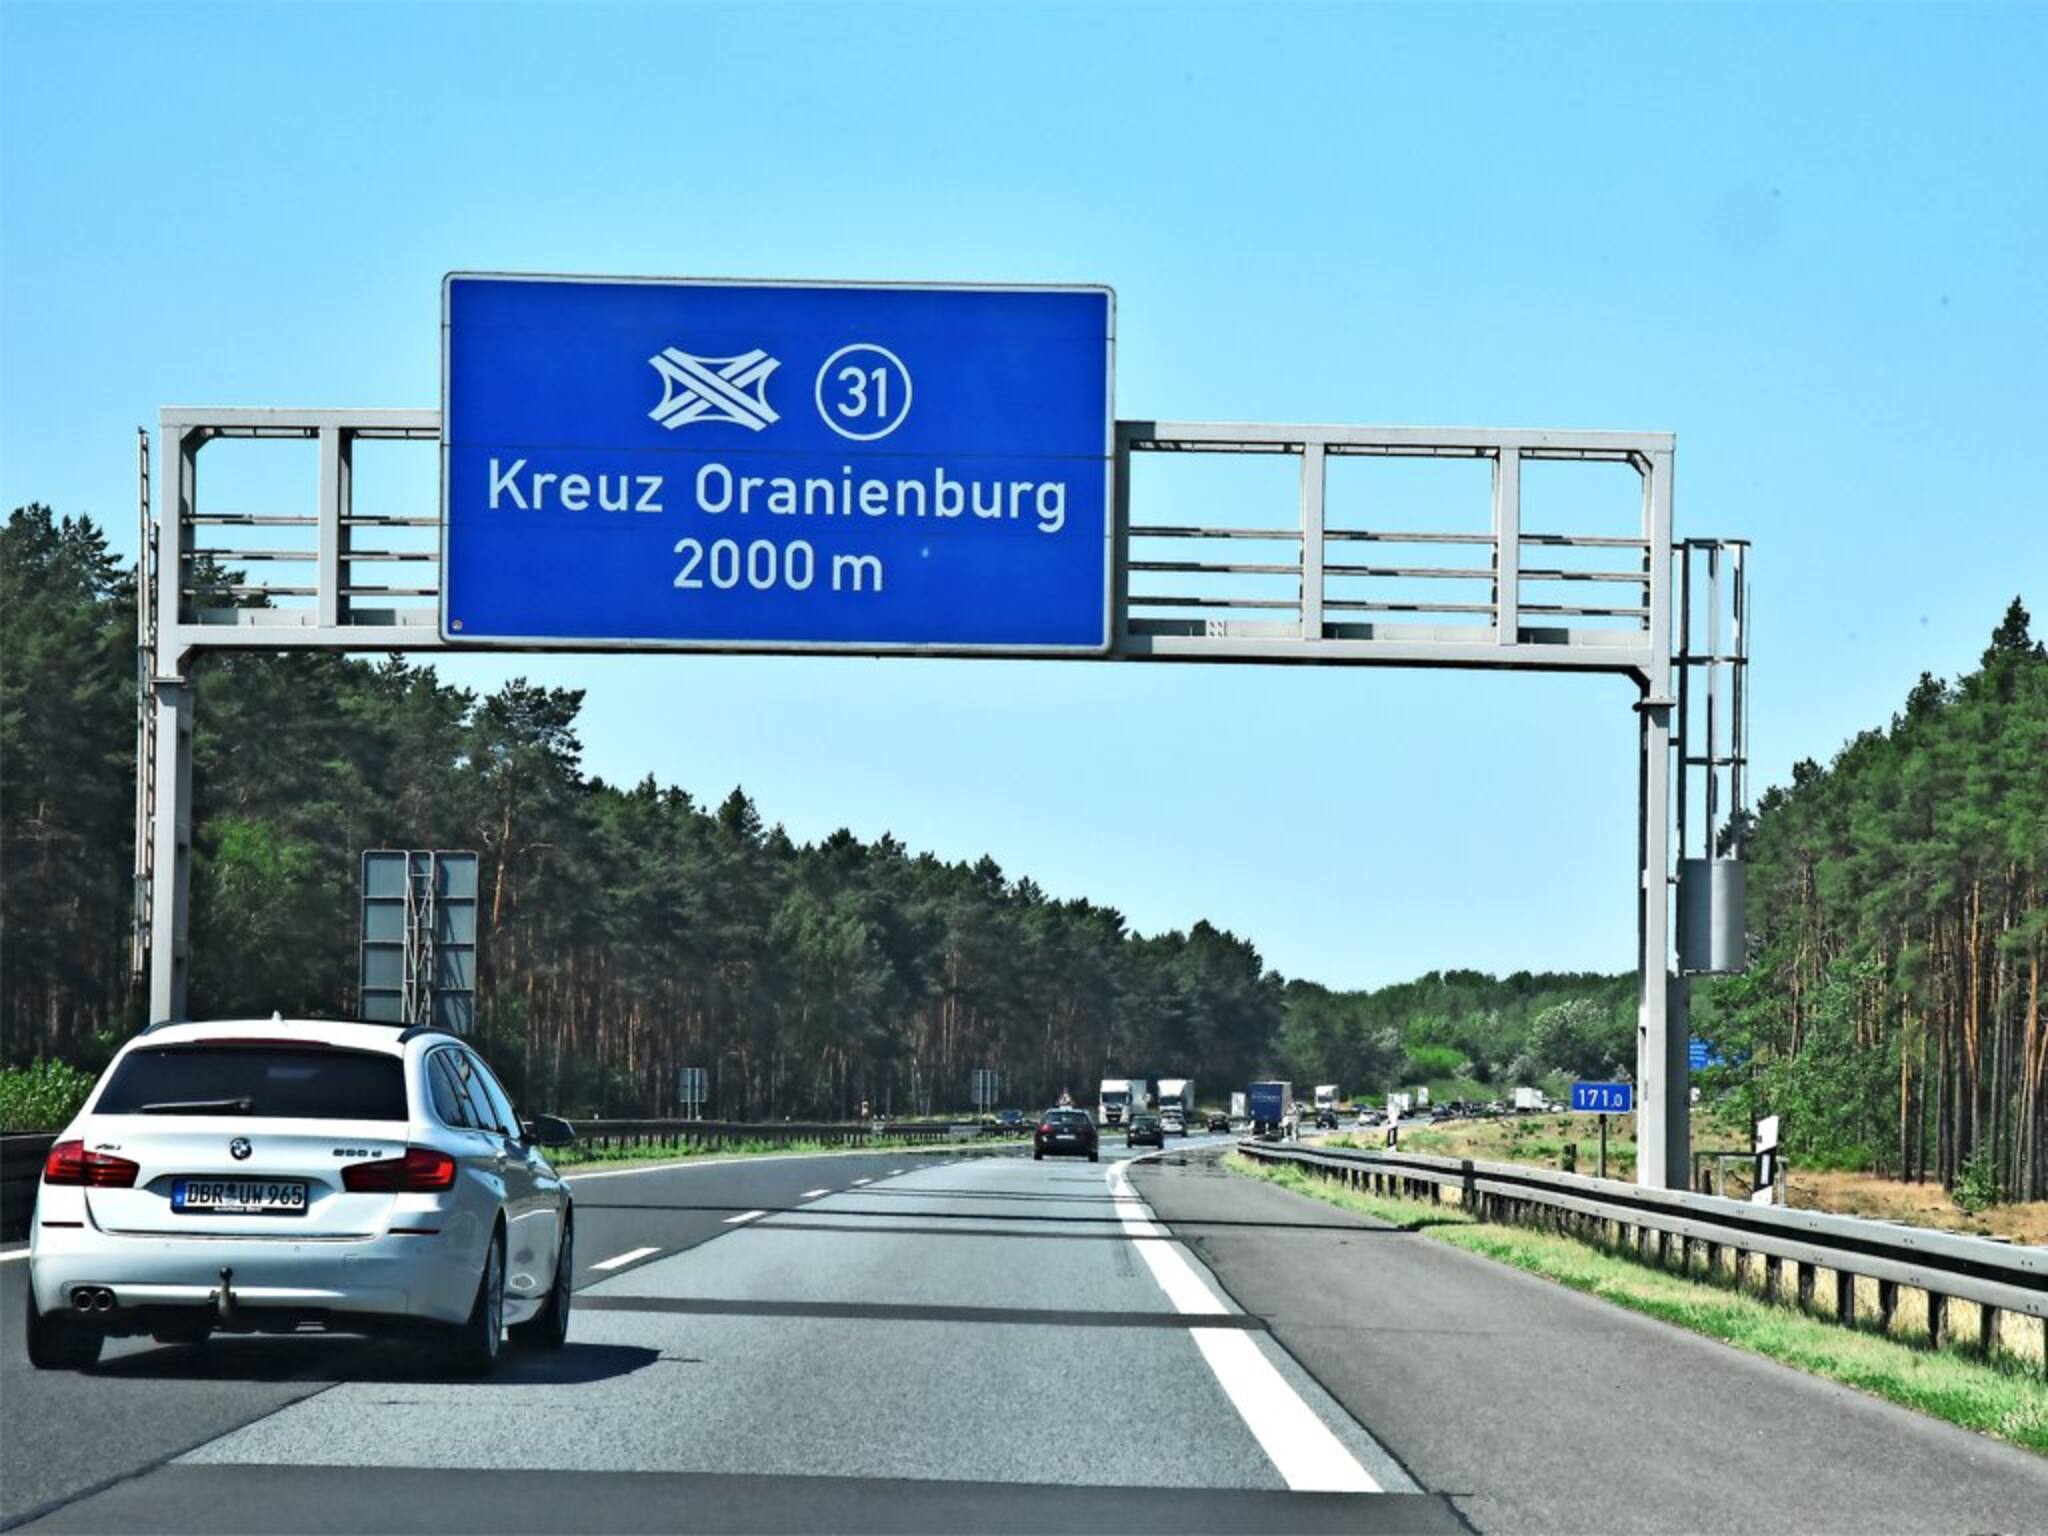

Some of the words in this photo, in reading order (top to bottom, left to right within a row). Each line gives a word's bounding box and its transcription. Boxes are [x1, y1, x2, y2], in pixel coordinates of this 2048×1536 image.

[837, 366, 887, 417] 31
[488, 458, 663, 513] Kreuz
[696, 463, 1065, 533] Oranienburg
[673, 538, 814, 590] 2000
[832, 555, 883, 591] m
[187, 1183, 225, 1203] DBR
[268, 1185, 303, 1206] 965
